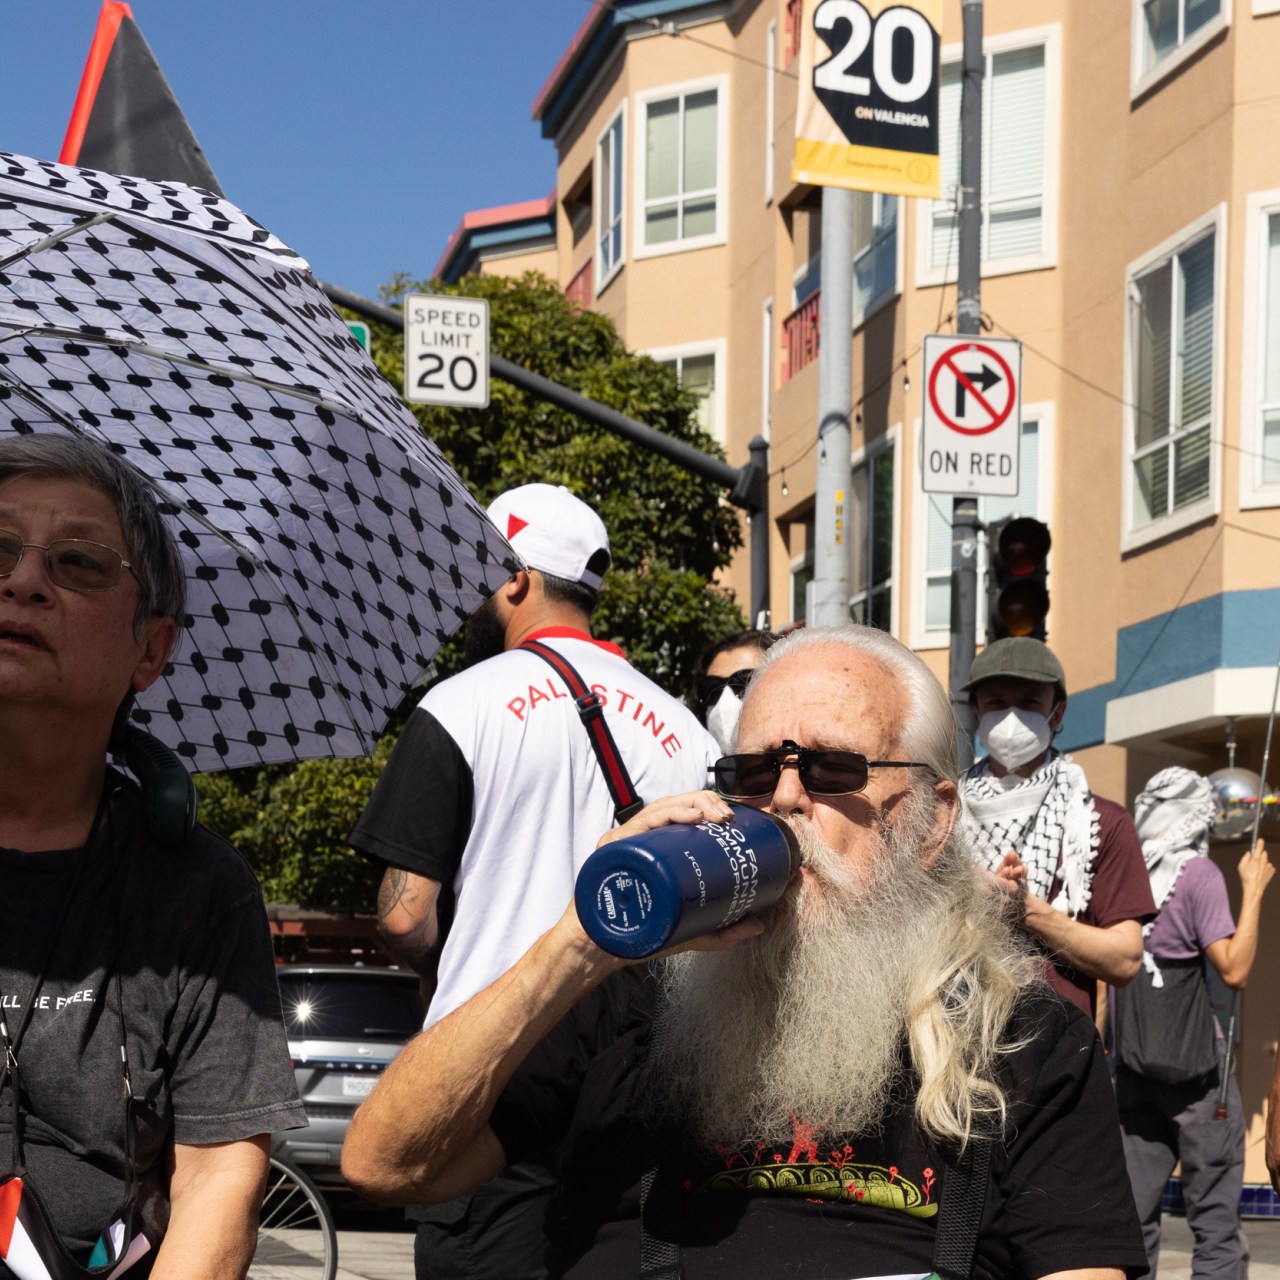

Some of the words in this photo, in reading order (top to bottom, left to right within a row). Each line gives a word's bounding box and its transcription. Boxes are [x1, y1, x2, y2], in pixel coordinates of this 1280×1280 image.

[814, 0, 933, 103] 20
[854, 106, 874, 120] ON
[873, 108, 930, 128] VALENCIA
[414, 308, 481, 328] SPEED
[421, 330, 472, 349] LIMIT
[417, 353, 478, 392] 20
[929, 450, 959, 474] ON
[970, 452, 1012, 477] RED
[506, 678, 682, 759] PALSTINE
[684, 850, 706, 908] LFCD.ORG
